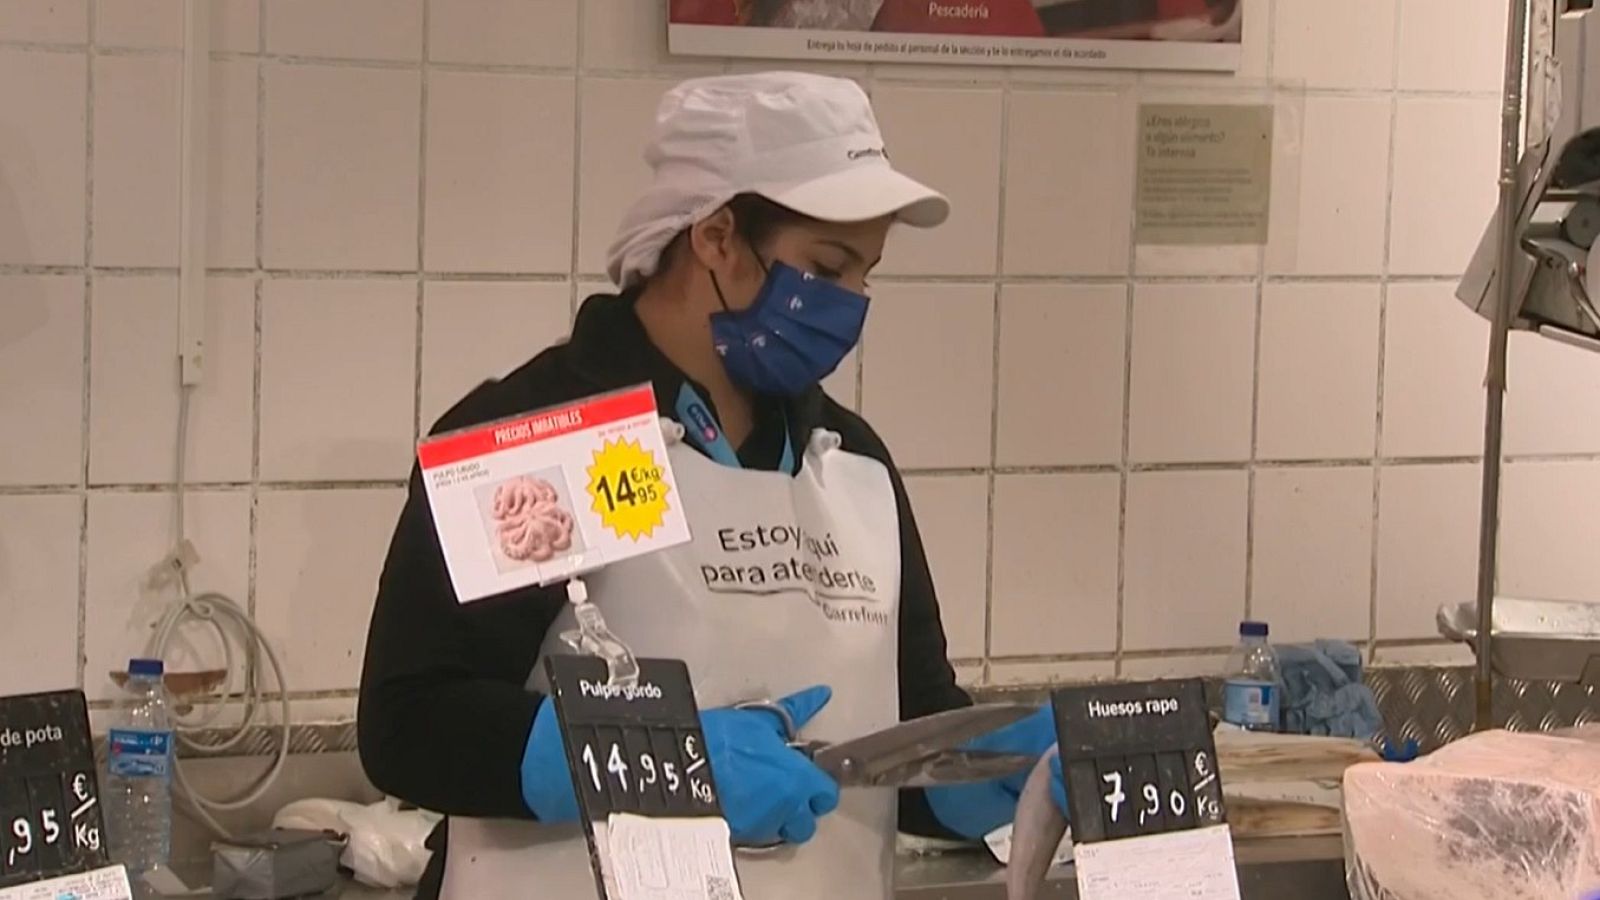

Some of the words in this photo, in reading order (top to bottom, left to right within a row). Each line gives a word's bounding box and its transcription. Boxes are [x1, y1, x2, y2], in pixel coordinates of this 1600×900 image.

[929, 1, 989, 19] Pescadería
[807, 39, 836, 52] Entrega
[846, 40, 862, 52] hoja
[864, 42, 873, 51] de
[908, 43, 939, 54] personal
[941, 43, 950, 54] de
[1010, 48, 1051, 58] entregamos
[494, 422, 532, 445] PRECIOS
[597, 470, 637, 512] 14
[637, 483, 657, 503] 95
[718, 525, 801, 552] Estoy
[700, 563, 766, 585] para
[771, 556, 877, 593] atederte
[580, 679, 621, 700] Pulpo
[622, 682, 662, 701] gordo
[1088, 701, 1143, 718] Huesos
[1146, 697, 1179, 715] rape
[0, 728, 21, 746] de
[25, 724, 62, 748] pota
[582, 743, 680, 793] 14,95
[1103, 771, 1185, 825] 7,90
